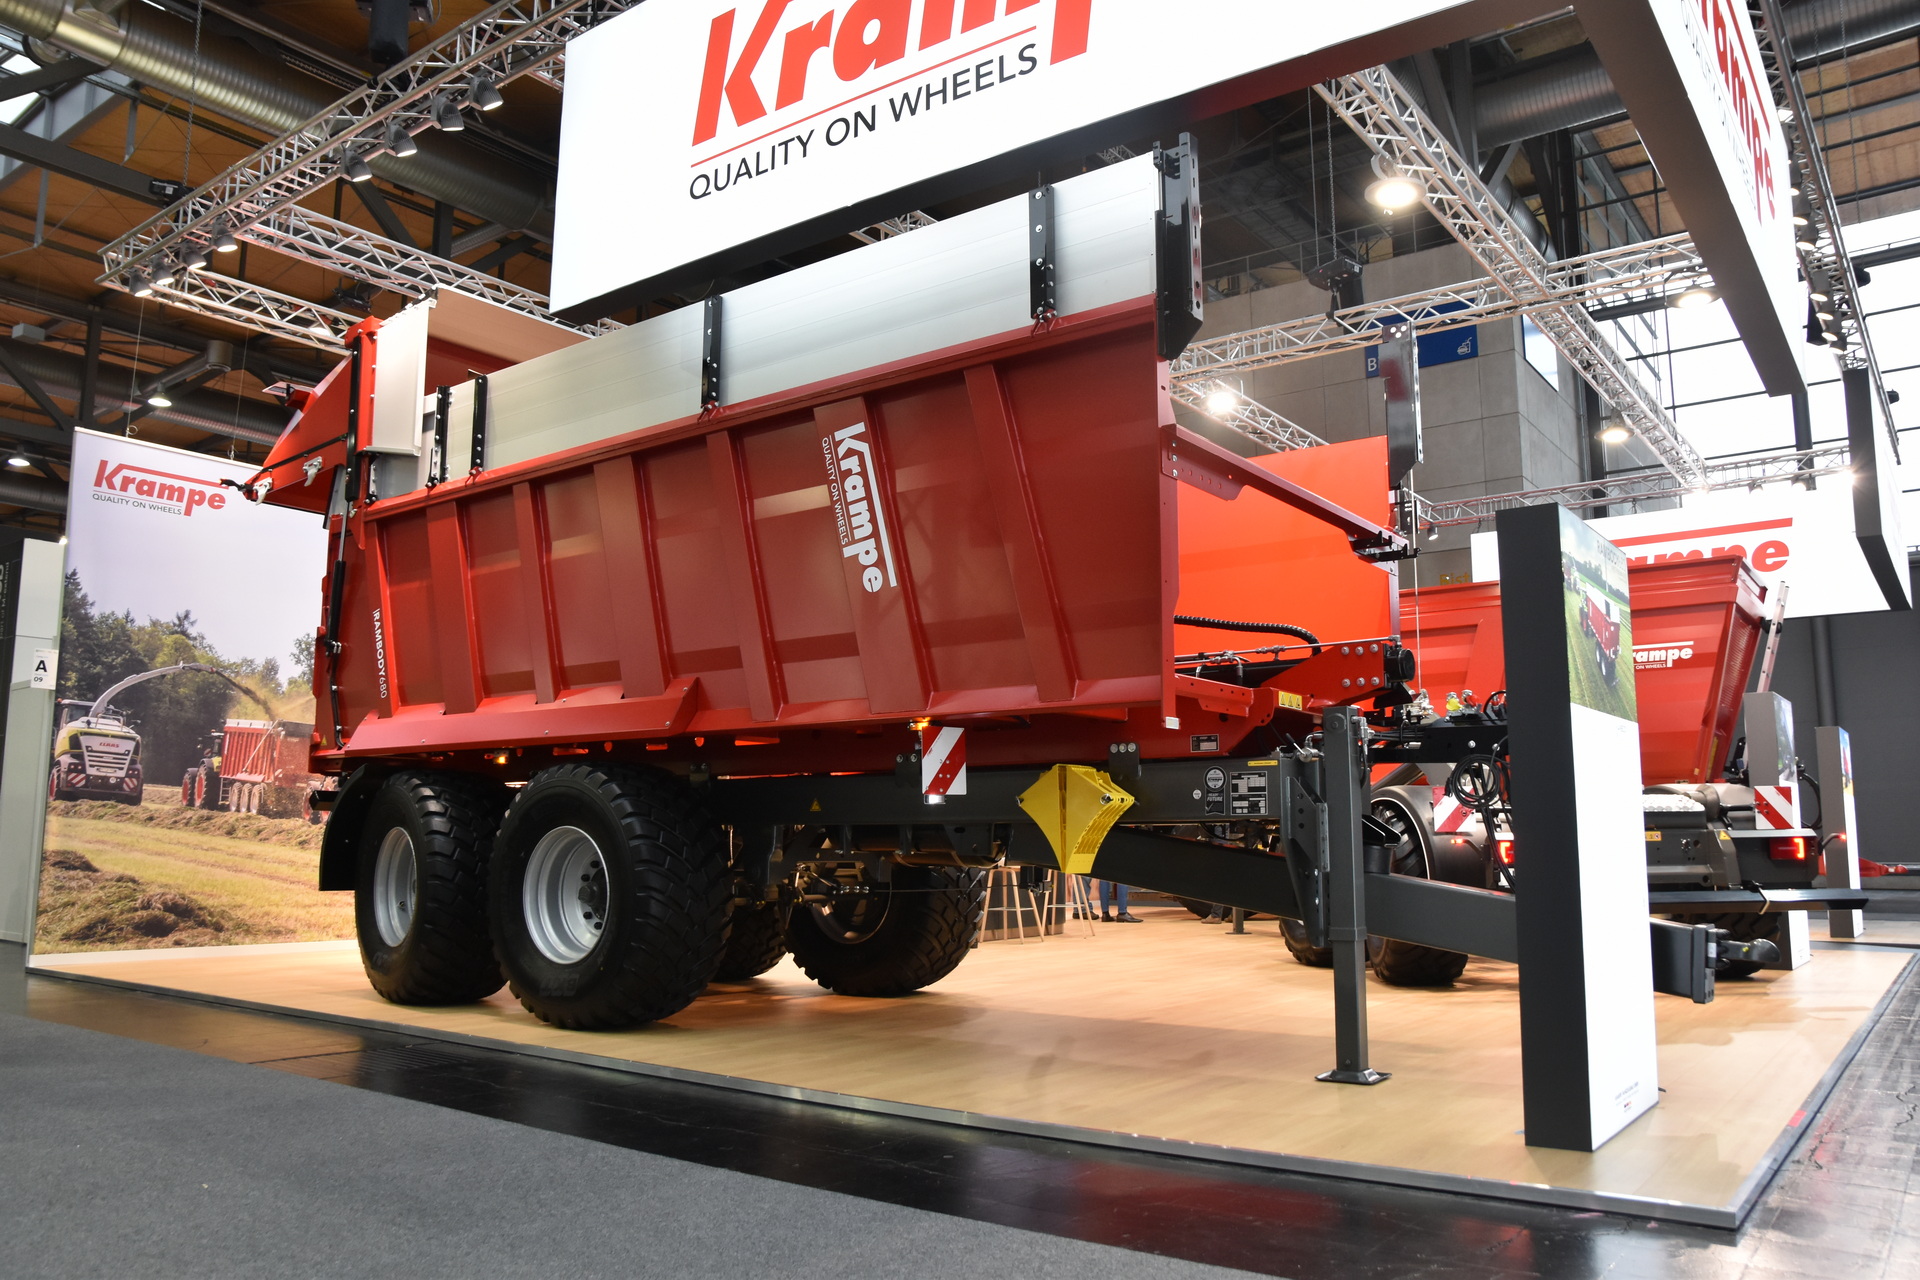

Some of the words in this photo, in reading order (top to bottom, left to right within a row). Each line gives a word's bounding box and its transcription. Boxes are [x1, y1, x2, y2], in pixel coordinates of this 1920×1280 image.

[692, 0, 1092, 147] Kra
[689, 129, 815, 200] QUALITY
[825, 104, 877, 147] ON
[889, 43, 1038, 124] WHEELS
[822, 437, 836, 480] QUALITY
[92, 493, 131, 506] QUALITY
[132, 500, 146, 509] ON
[149, 503, 182, 515] WHEELS
[93, 459, 230, 517] Krampe
[830, 484, 840, 501] ON
[834, 421, 897, 593] Krampe
[834, 502, 848, 545] WHEELS
[373, 612, 386, 675] RAMBODY
[35, 659, 48, 673] A
[379, 677, 388, 699] 680
